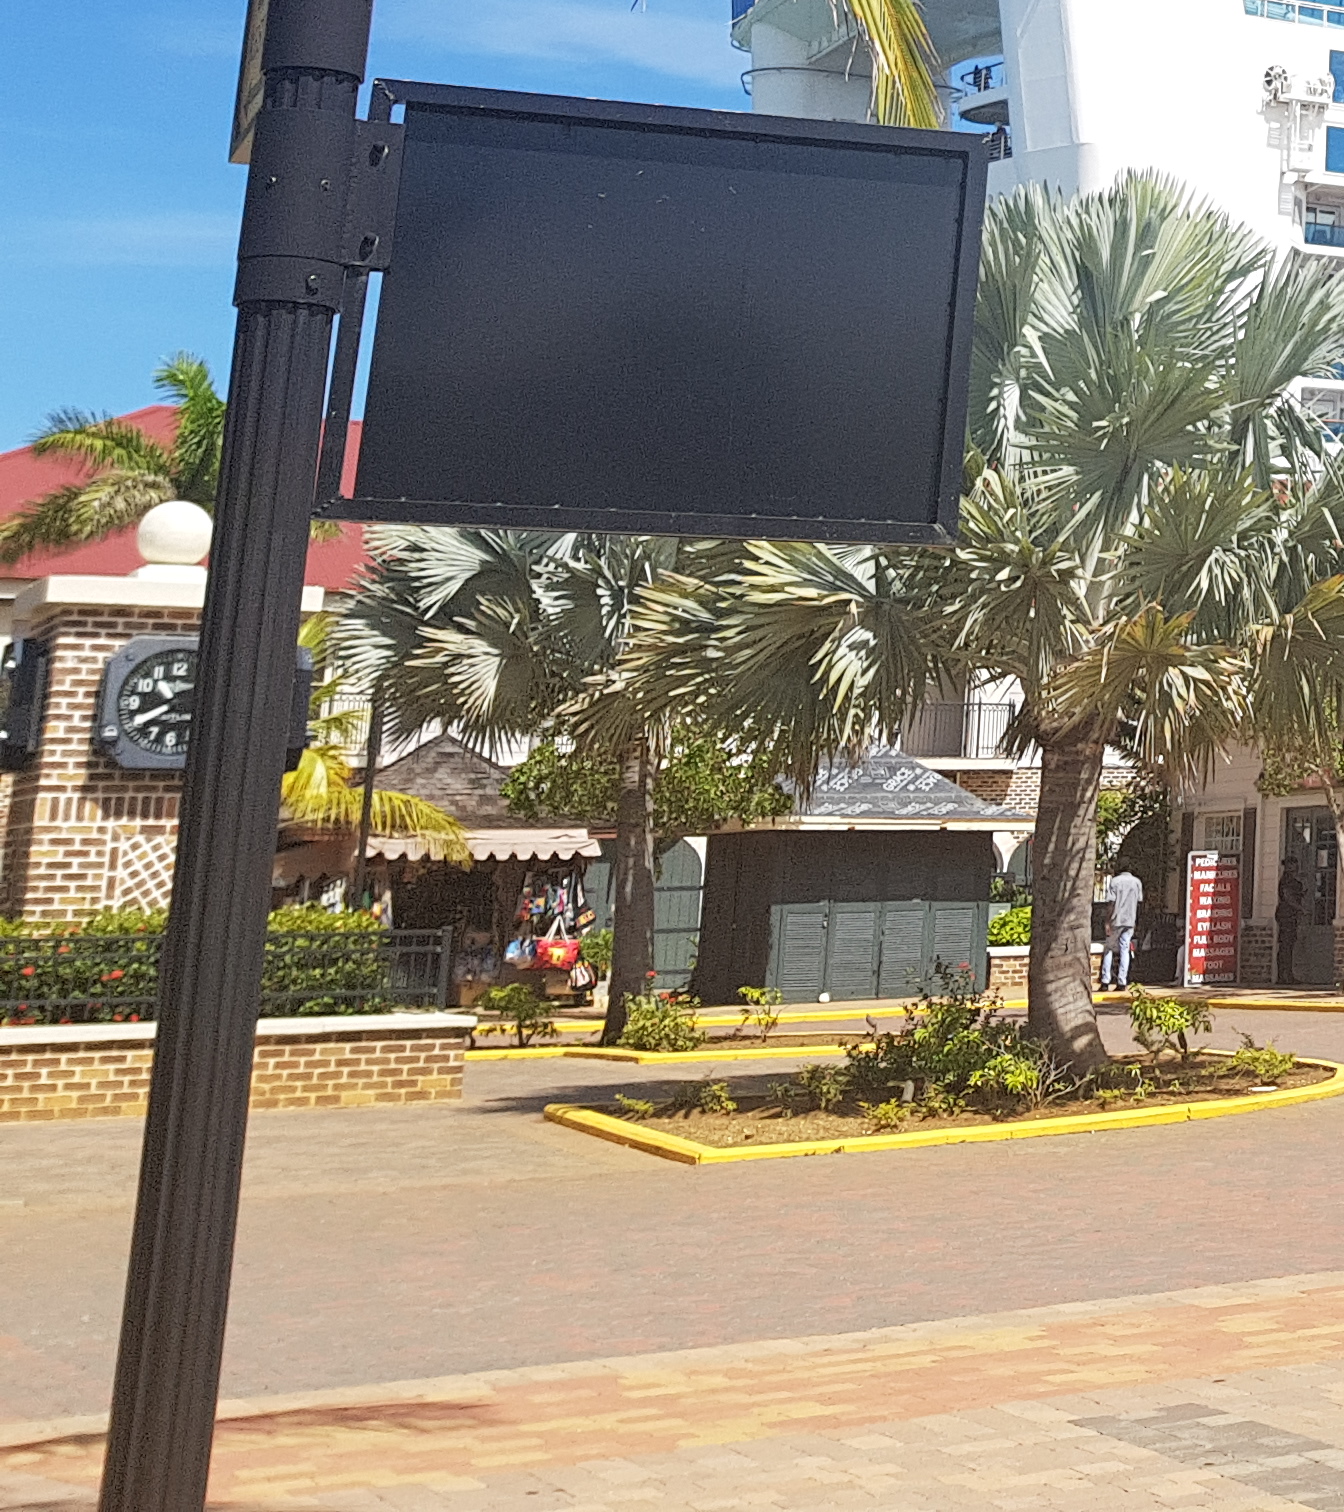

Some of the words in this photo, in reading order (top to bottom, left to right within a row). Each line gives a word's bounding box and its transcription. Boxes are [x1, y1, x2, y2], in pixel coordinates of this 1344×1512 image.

[153, 665, 165, 680] 11
[172, 661, 188, 676] 12
[137, 677, 154, 693] 10
[128, 694, 140, 710] 9
[146, 725, 160, 741] 7
[165, 731, 177, 747] 6
[1197, 921, 1232, 931] EYELASH
[1193, 935, 1212, 944] FULL
